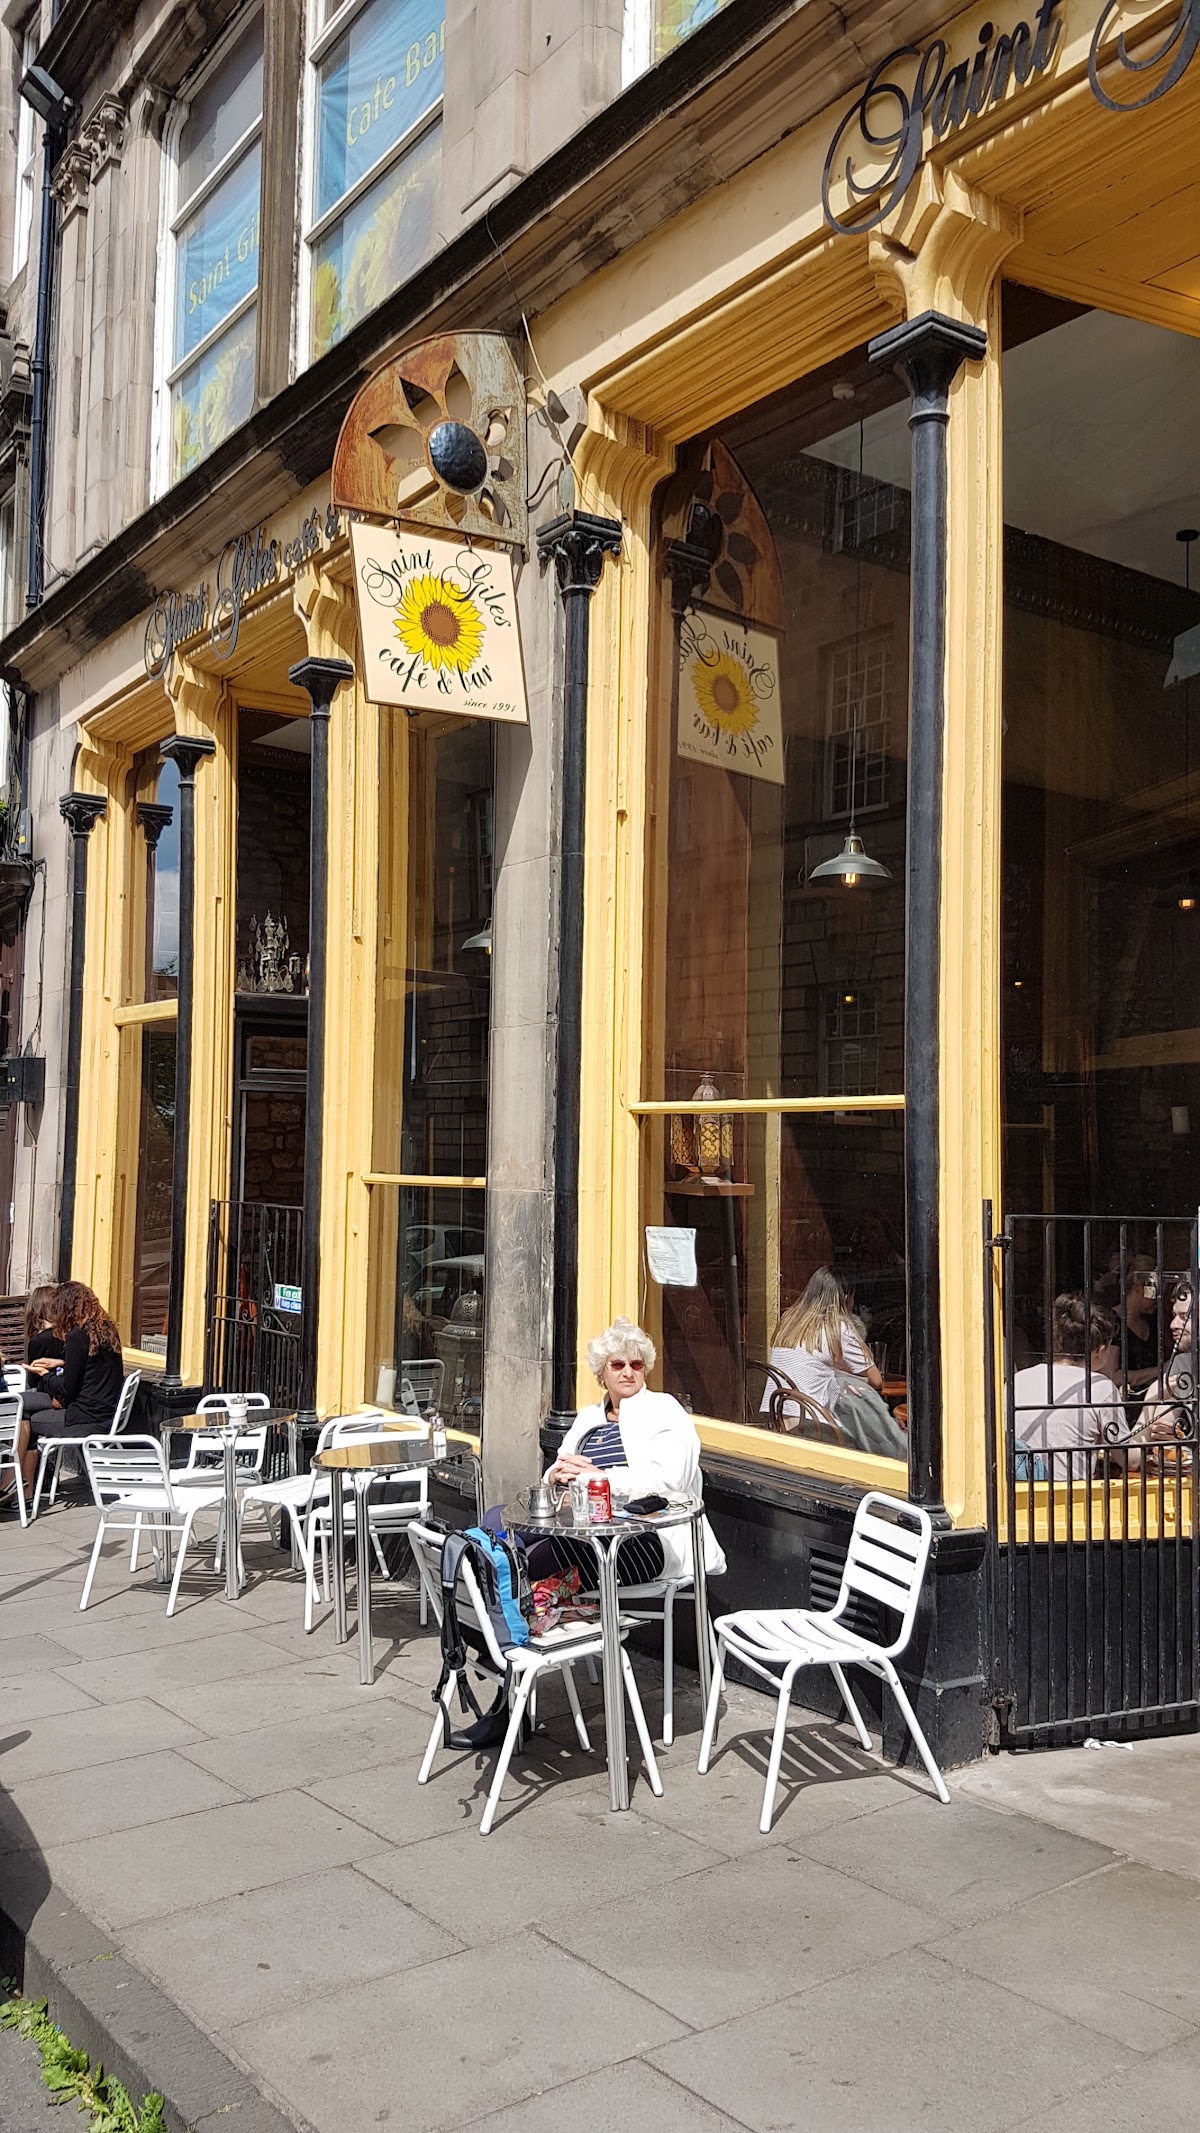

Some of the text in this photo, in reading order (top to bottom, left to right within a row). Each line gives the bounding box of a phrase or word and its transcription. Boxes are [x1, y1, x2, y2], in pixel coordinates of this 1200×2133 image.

[346, 73, 397, 147] Cafe
[822, 0, 1063, 235] Saint
[189, 244, 230, 315] Saint
[144, 503, 340, 680] Saint Giles café &
[361, 549, 512, 627] Saint Giles
[378, 648, 493, 695] café & bar
[463, 698, 517, 713] since 1991
